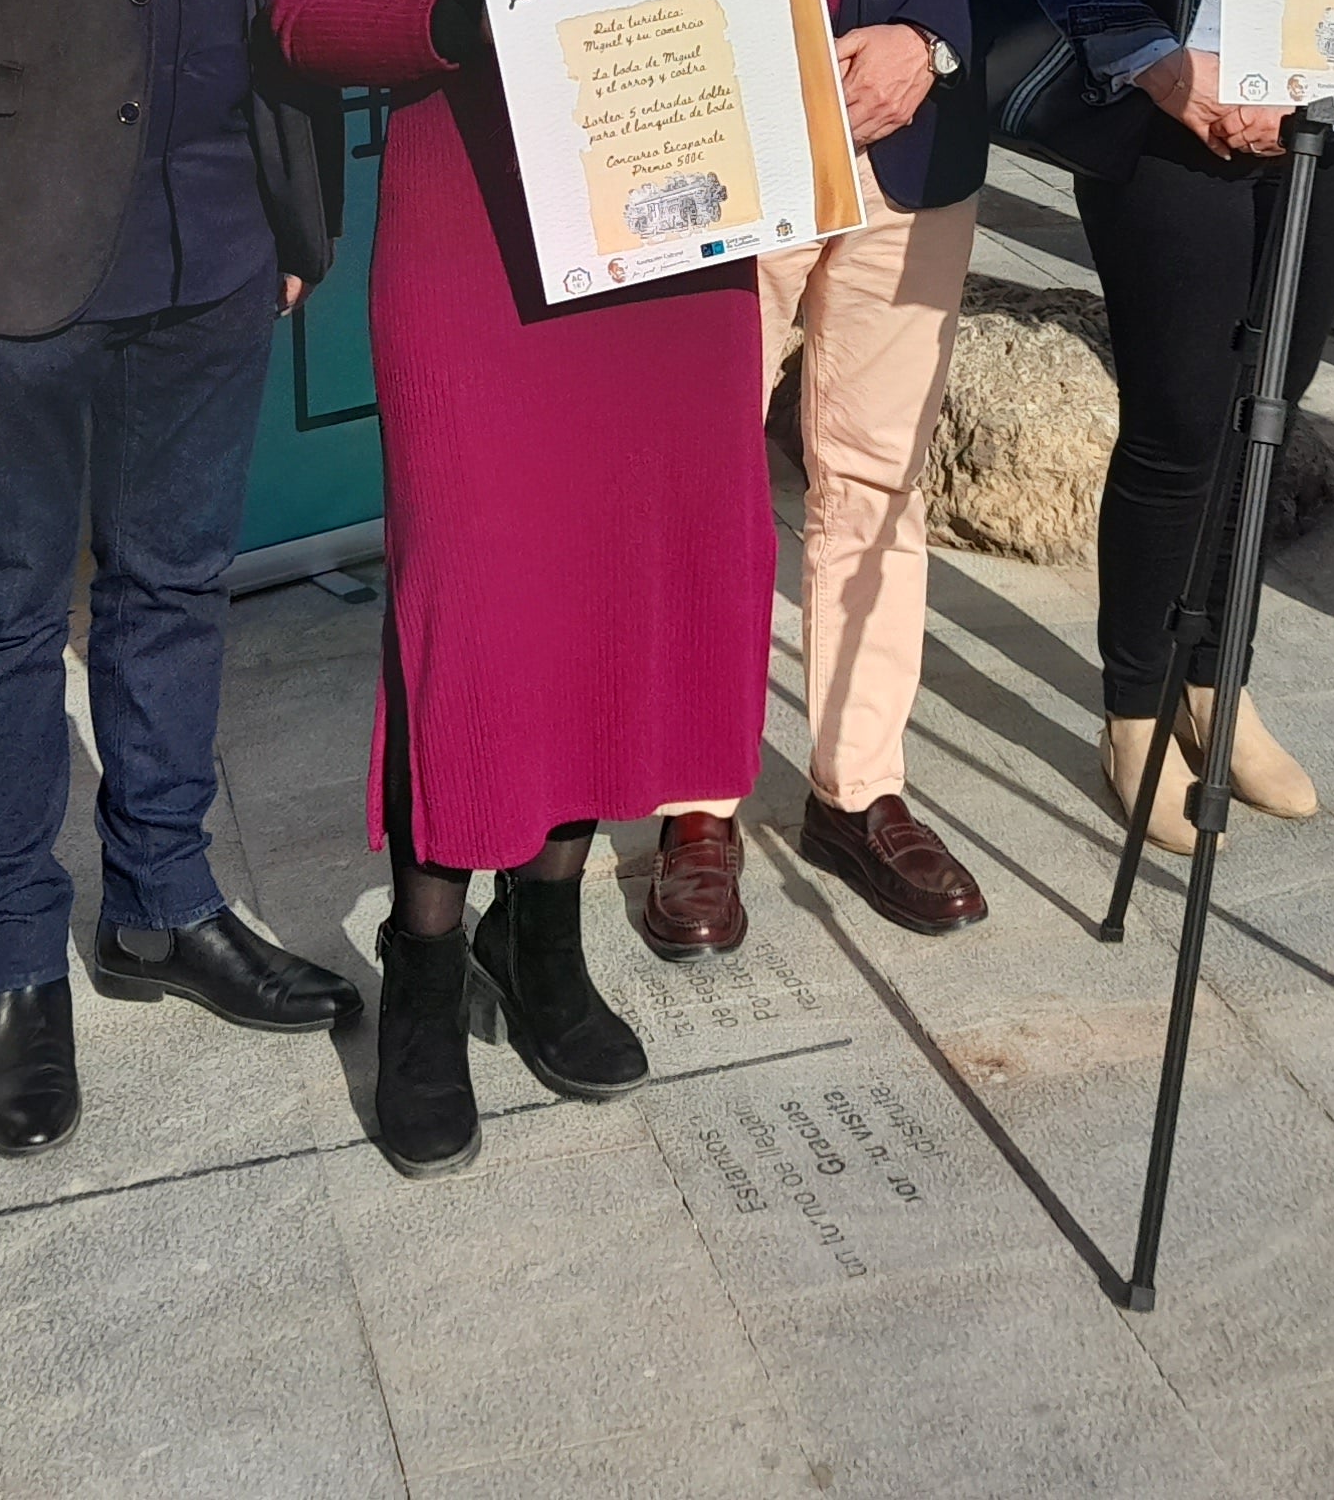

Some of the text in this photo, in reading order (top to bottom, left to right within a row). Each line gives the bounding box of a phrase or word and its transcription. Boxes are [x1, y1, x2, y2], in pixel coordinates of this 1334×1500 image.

[583, 19, 705, 54] Miguel y su comercio
[593, 19, 623, 36] Ruta
[592, 44, 702, 81] La boda de Miguel
[595, 61, 707, 99] y el arroz y costra
[629, 106, 637, 119] 5
[641, 93, 695, 115] entradas
[698, 84, 732, 102] dobles
[589, 97, 735, 146] para el banquete de boda
[606, 130, 726, 169] Concurso Escaparate
[631, 161, 673, 177] Premio
[779, 1099, 847, 1177] Gracias
